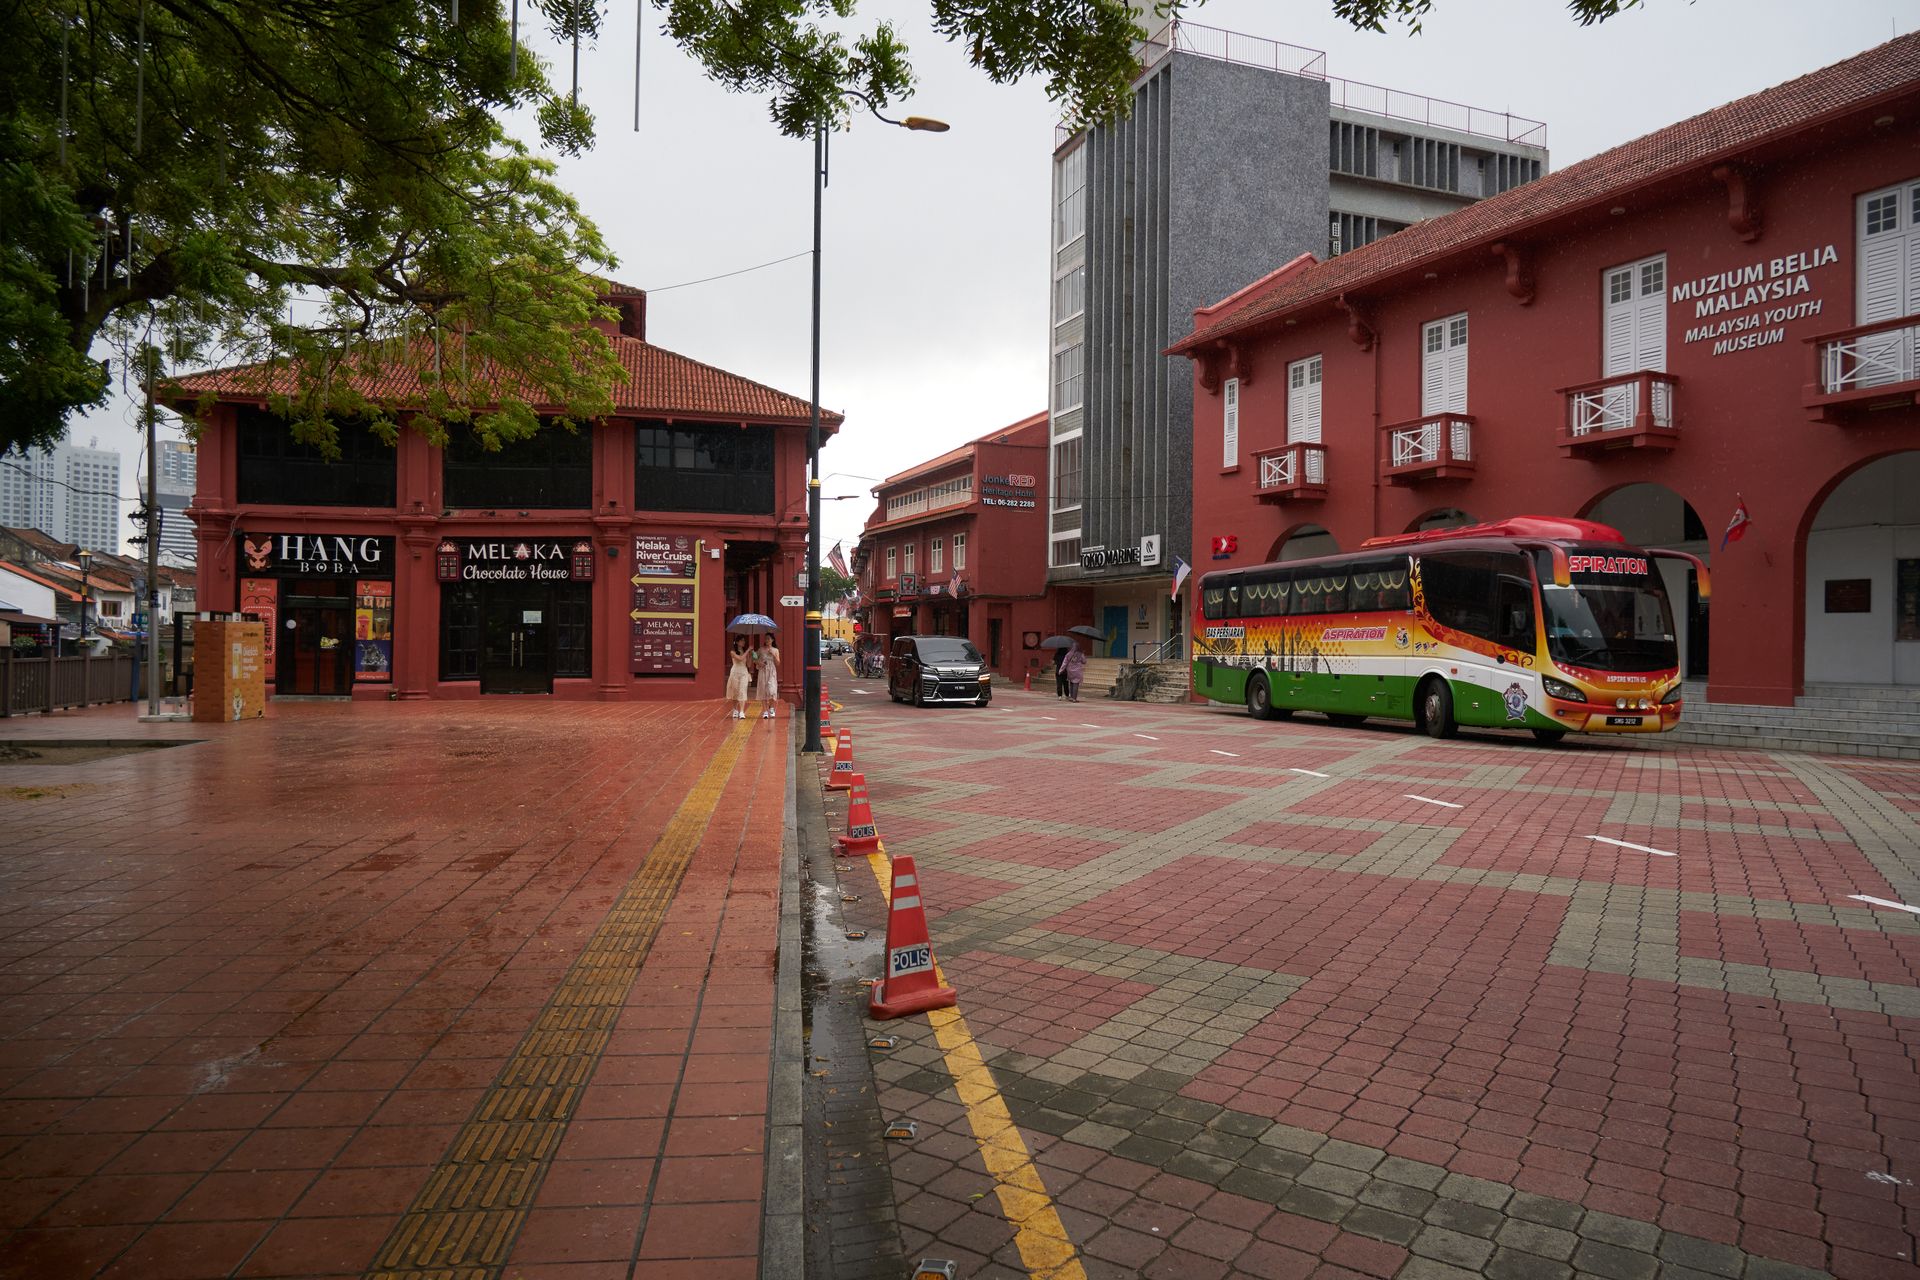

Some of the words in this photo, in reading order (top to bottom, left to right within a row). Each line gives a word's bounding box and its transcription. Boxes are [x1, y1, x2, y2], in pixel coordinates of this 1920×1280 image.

[1672, 263, 1764, 303] MUZIUM
[1770, 244, 1838, 278] BELIA
[1695, 274, 1810, 319] MALAYSIA
[1685, 313, 1760, 344] MALAYSIA
[1764, 299, 1822, 325] YOUTH
[1713, 327, 1784, 356] MUSEUM
[279, 535, 382, 563] HANG
[468, 543, 564, 560] MELAKA
[636, 541, 670, 550] Melaka
[636, 550, 662, 560] River
[662, 551, 693, 561] Cruise
[1080, 551, 1105, 568] TOKIO
[1106, 547, 1140, 566] MARINE
[300, 562, 360, 574] BOBA
[463, 564, 527, 580] Chocolate
[529, 563, 569, 580] House
[1568, 556, 1648, 575] SPIRATION
[1322, 627, 1388, 642] ASPIRATION
[836, 762, 853, 771] POLIS
[852, 826, 875, 838] POLIS
[894, 949, 930, 972] POLIS
